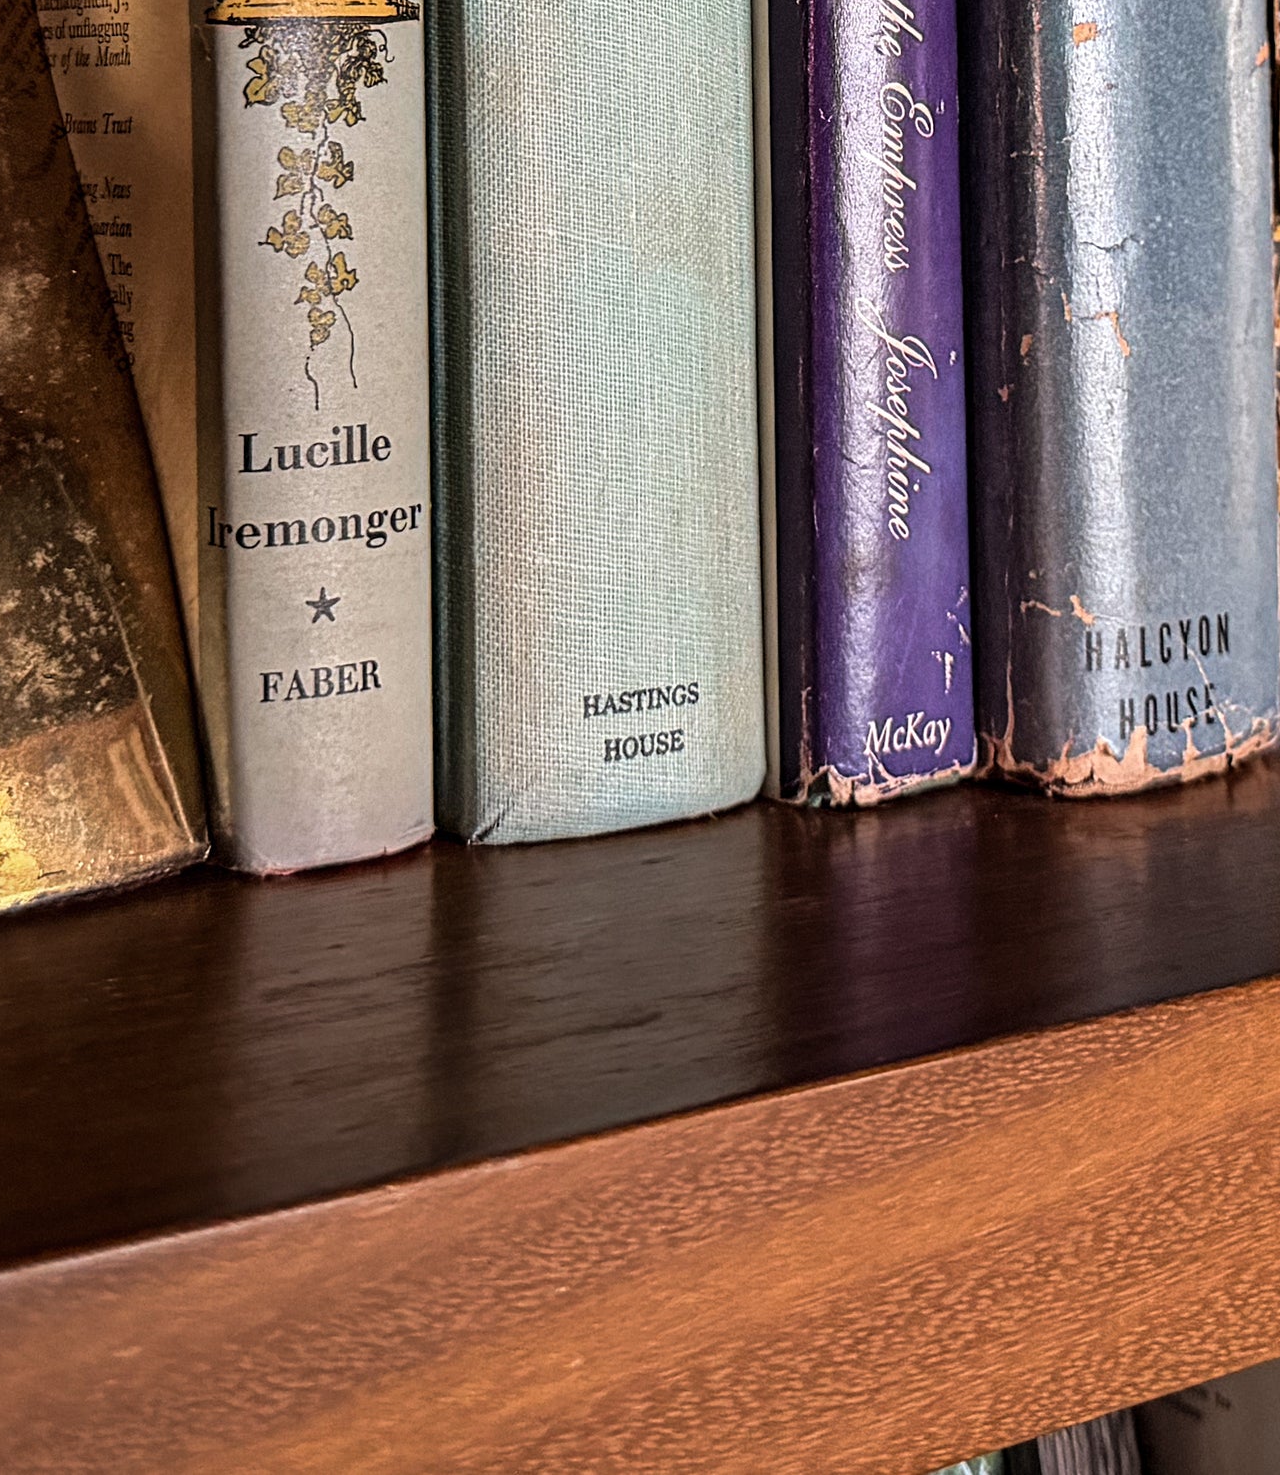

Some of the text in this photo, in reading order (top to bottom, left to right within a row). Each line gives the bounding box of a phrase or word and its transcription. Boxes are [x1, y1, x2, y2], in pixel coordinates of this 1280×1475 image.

[55, 18, 68, 41] of
[69, 16, 131, 44] unflagging
[60, 45, 73, 75] of
[74, 44, 91, 68] the
[94, 44, 132, 68] Month
[101, 112, 134, 136] Trust
[868, 80, 935, 275] Empress
[107, 252, 134, 277] The
[855, 295, 939, 541] Josephine
[238, 422, 393, 474] Lucille
[207, 503, 423, 550] Iremonger
[1084, 611, 1231, 672] HALCYON
[260, 659, 382, 703] FABER
[583, 681, 701, 719] HASTINGS
[862, 710, 952, 756] McKay
[1119, 682, 1218, 740] HOUSE
[603, 728, 685, 764] HOUSE
